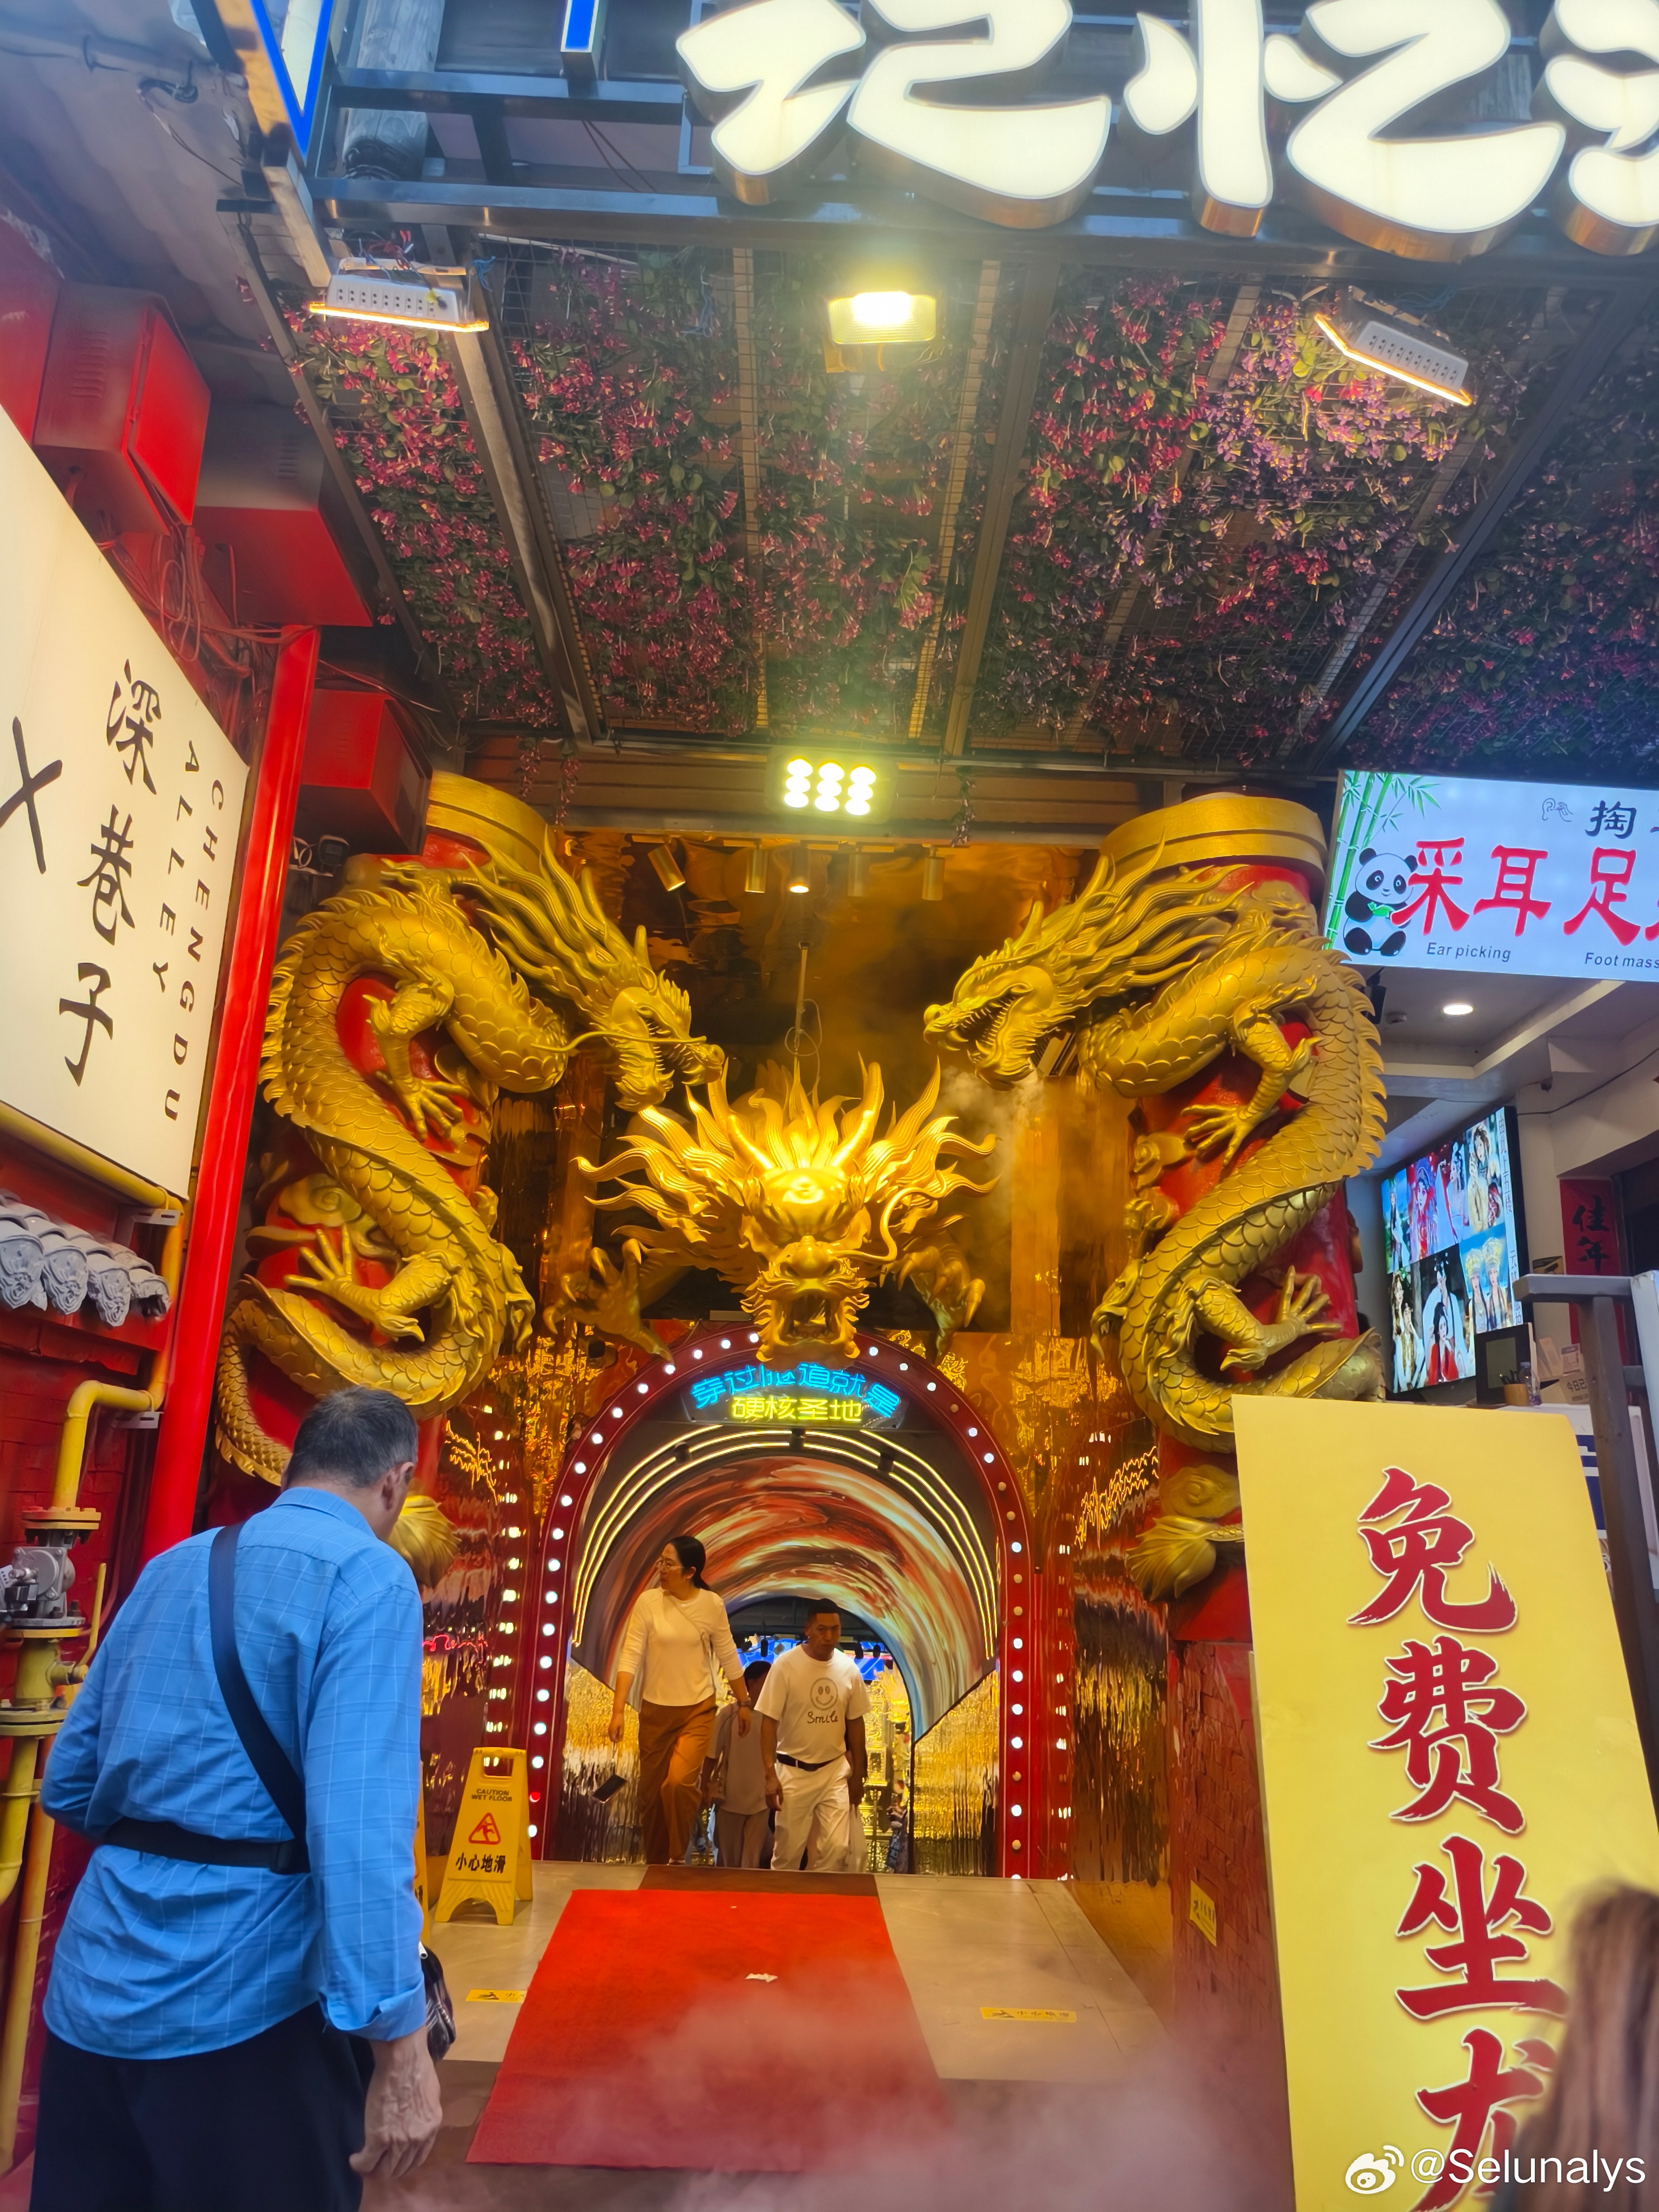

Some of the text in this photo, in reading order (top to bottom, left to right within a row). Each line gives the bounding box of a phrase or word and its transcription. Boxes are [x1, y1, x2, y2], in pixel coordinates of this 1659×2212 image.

[676, 0, 1659, 235] 记忆
[1584, 800, 1659, 839] 掏
[59, 659, 161, 1087] 深巷子
[152, 740, 199, 993] ALLEY
[1390, 837, 1659, 947] 采耳足
[164, 779, 224, 1122] CHENGDU
[1427, 942, 1511, 963] Ear picking
[1585, 952, 1619, 968] Foot
[732, 1394, 862, 1422] 硬核圣地
[807, 1710, 839, 1724] Smile
[455, 1852, 506, 1874] 小心地滑
